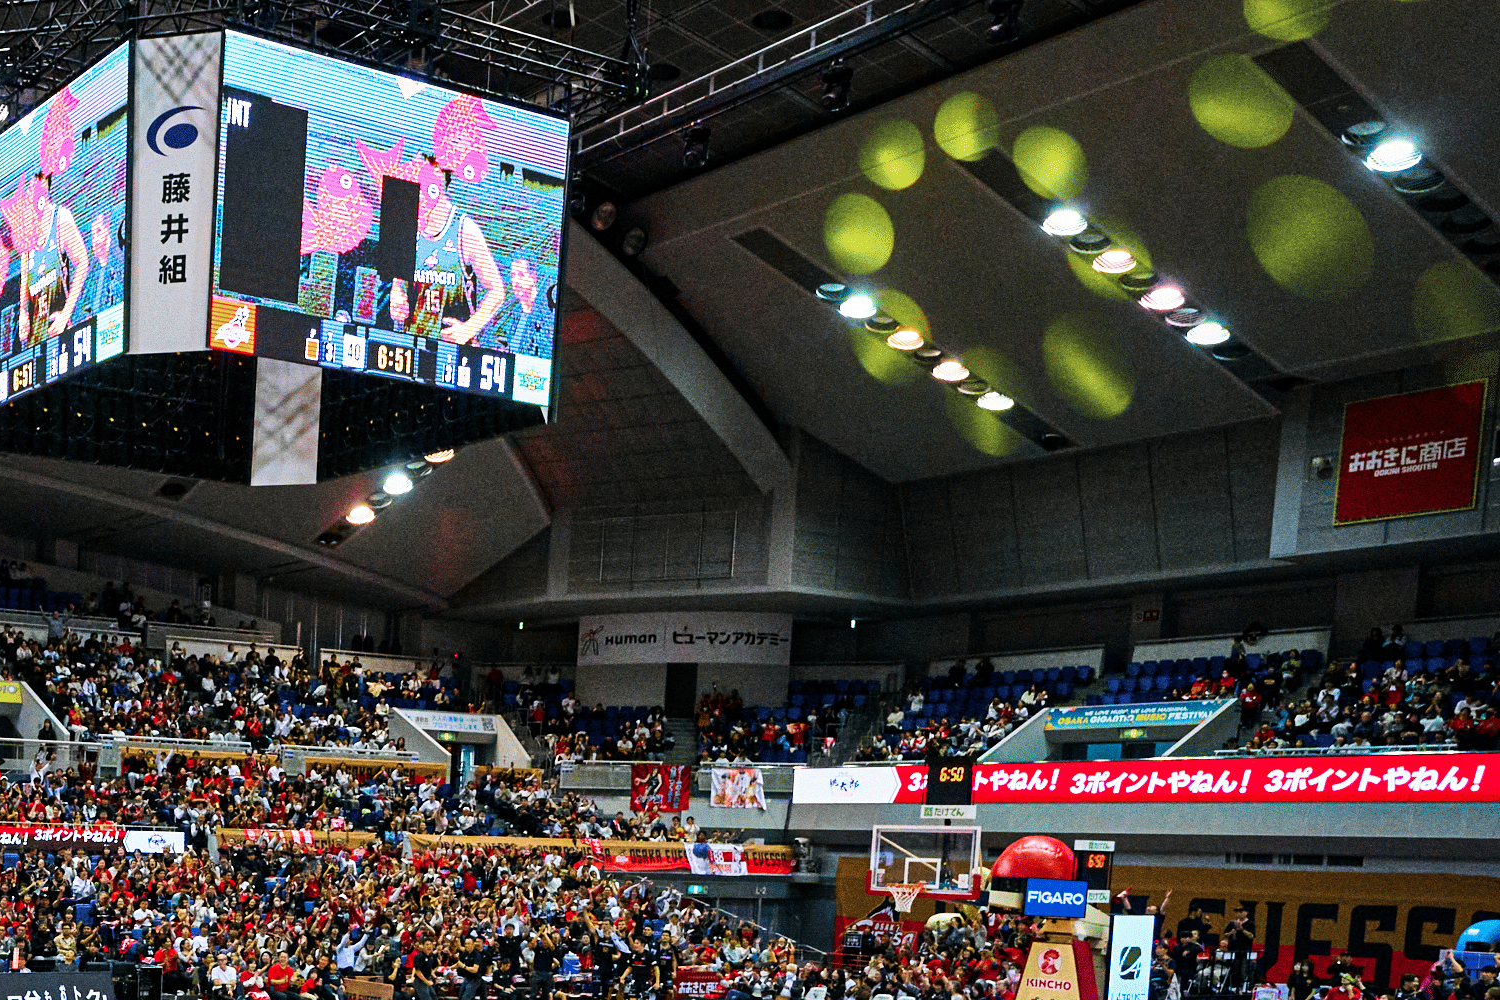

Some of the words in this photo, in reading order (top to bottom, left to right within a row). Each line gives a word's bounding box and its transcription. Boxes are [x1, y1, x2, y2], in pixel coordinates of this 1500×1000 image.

[158, 172, 191, 285] 藤井組
[12, 361, 34, 392] 6:51
[73, 325, 92, 368] 54
[377, 344, 412, 374] 6:51
[480, 355, 506, 393] 54
[1349, 437, 1468, 473] おおきに商店
[672, 630, 789, 646] ヒューマンアカデミー
[939, 766, 965, 783] 6:50
[1070, 769, 1250, 795] 3ポイントやねん!
[1264, 765, 1486, 793] 3ポイントやねん!
[33, 828, 120, 843] 3ポイントやねん!
[1027, 890, 1084, 906] FIGARO
[1026, 978, 1071, 991] KINCHO
